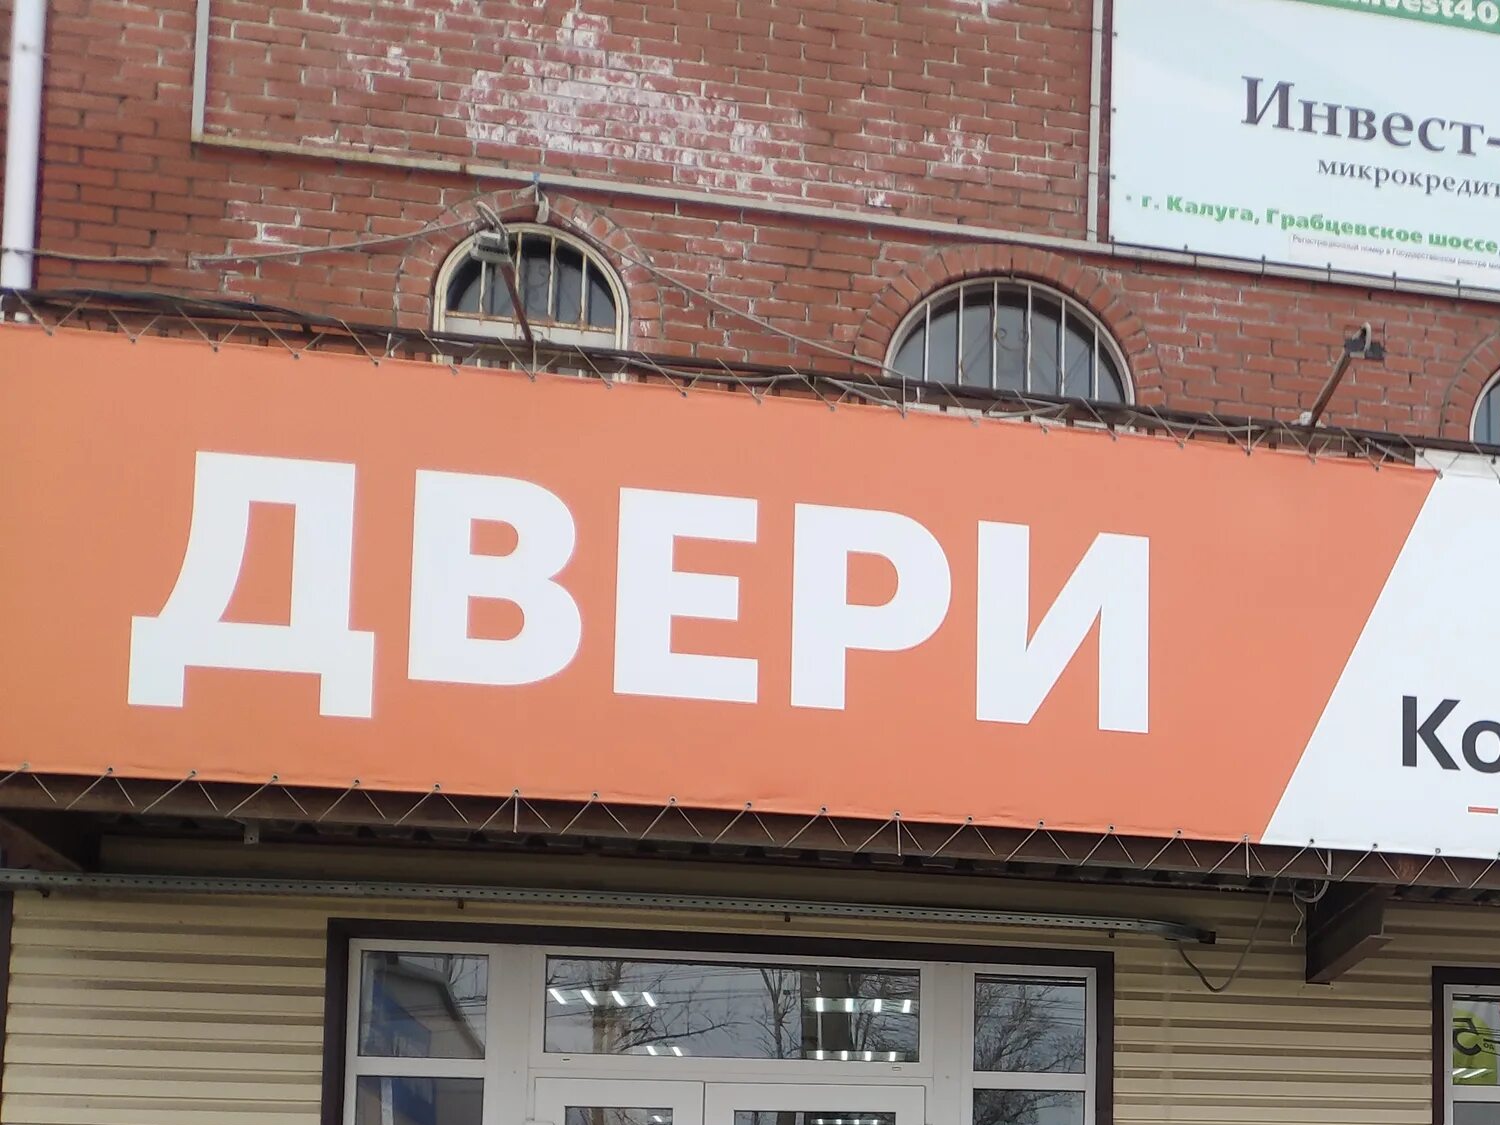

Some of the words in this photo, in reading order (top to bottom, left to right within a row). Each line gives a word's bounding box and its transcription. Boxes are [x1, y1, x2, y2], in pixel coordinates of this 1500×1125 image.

[1141, 196, 1159, 209] г.
[1166, 195, 1260, 225] Калуга,
[1266, 207, 1424, 243] Грабцевское
[127, 450, 1150, 734] ДВЕРИ
